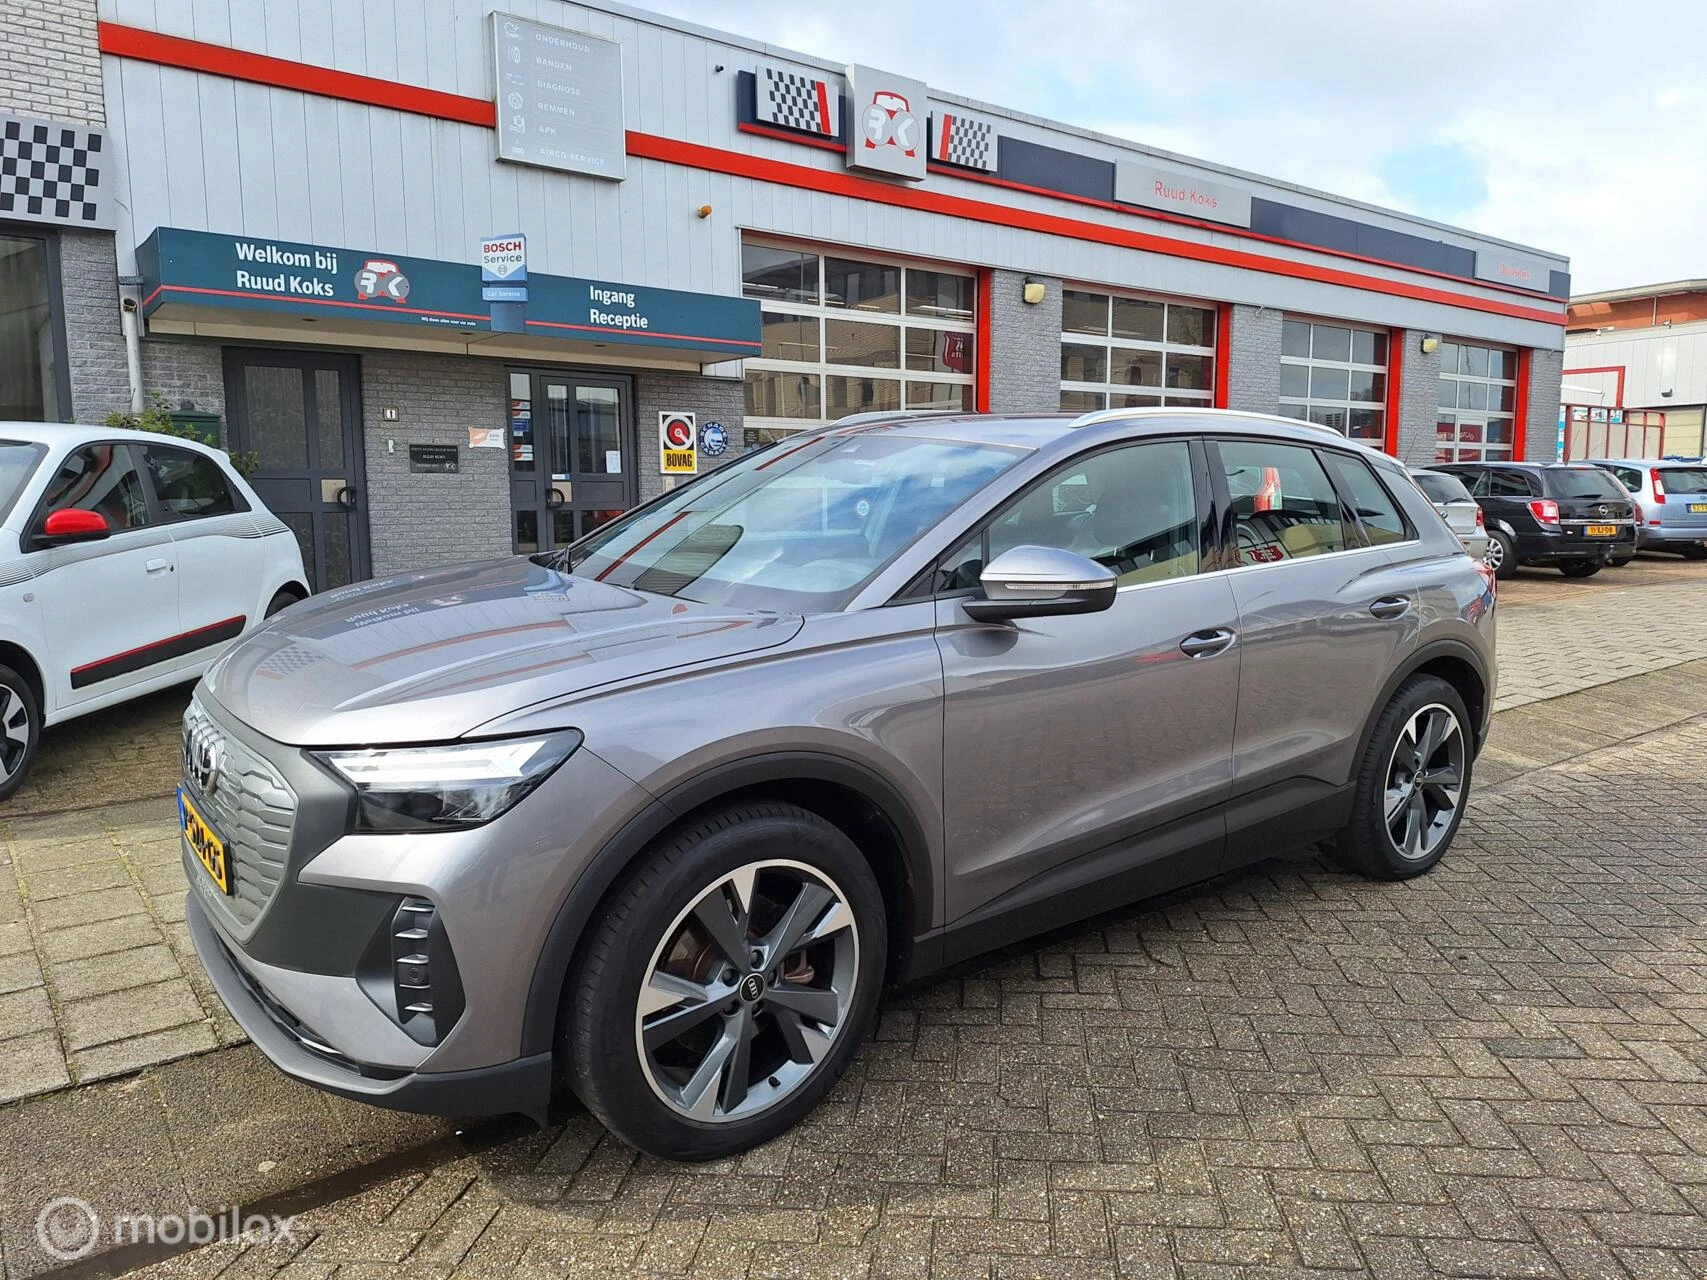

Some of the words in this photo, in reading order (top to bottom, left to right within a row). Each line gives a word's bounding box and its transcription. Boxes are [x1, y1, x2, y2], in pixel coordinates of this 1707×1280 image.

[535, 33, 590, 53] ONDERHOUD
[536, 57, 572, 72] BANDEN
[537, 80, 582, 97] DIAGNOSE
[538, 102, 575, 117] REMMEN
[539, 125, 557, 136] APK
[1154, 180, 1185, 201] Ruud
[1190, 189, 1218, 208] Koks
[483, 241, 522, 254] BOSCH
[235, 242, 311, 268] Welkom
[314, 250, 338, 275] bij
[483, 253, 523, 264] Service
[236, 270, 286, 292] Ruud
[289, 275, 334, 297] Koks
[589, 285, 636, 308] Ingang
[589, 308, 649, 330] Receptie
[666, 453, 693, 468] BOVAG
